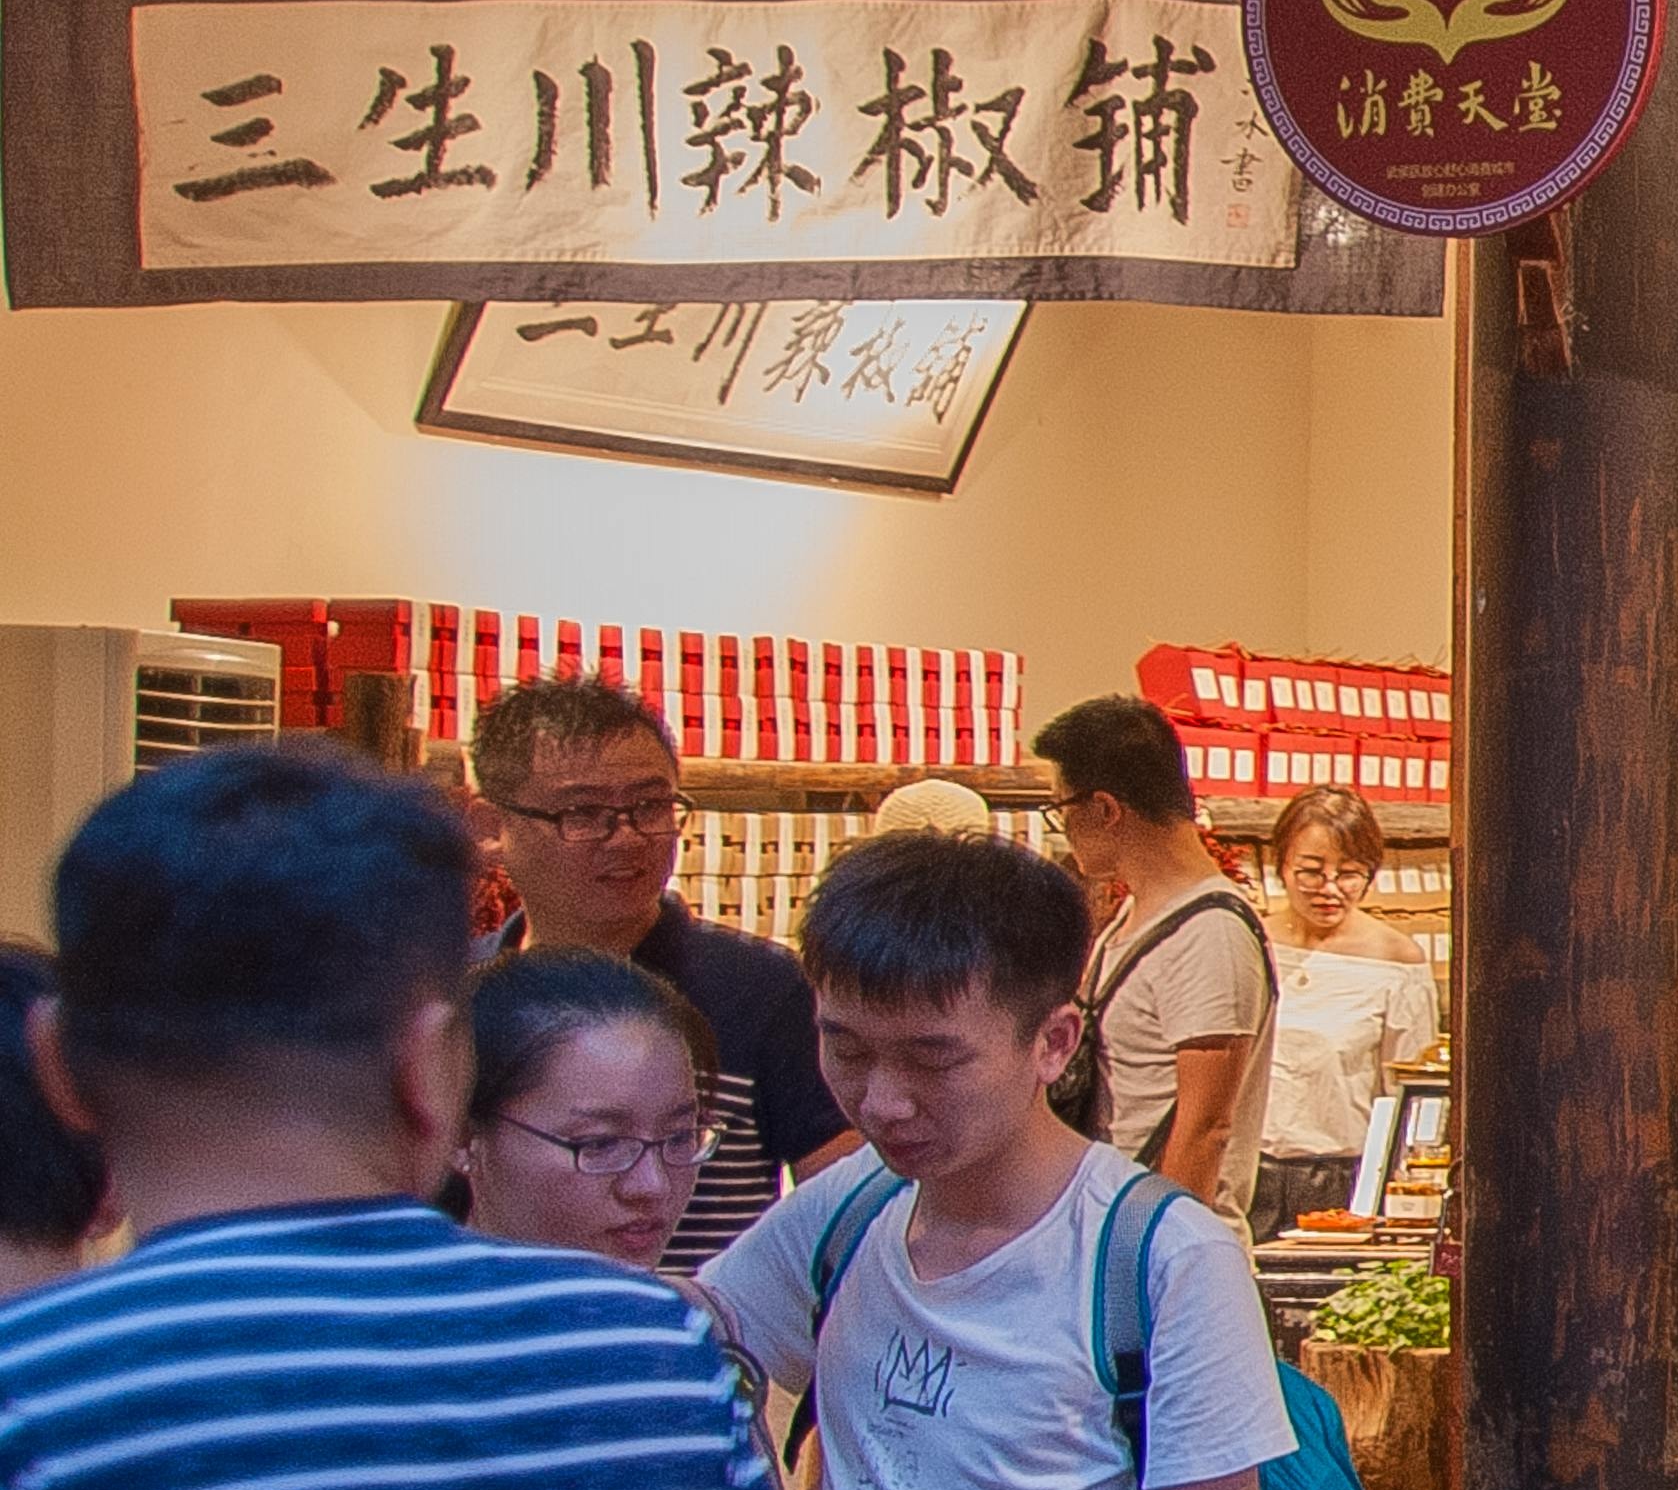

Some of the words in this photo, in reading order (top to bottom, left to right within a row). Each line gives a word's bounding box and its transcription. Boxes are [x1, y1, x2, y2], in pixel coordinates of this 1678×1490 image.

[173, 32, 1216, 227] 三生川辣椒铺
[1336, 60, 1563, 140] 消費天堂
